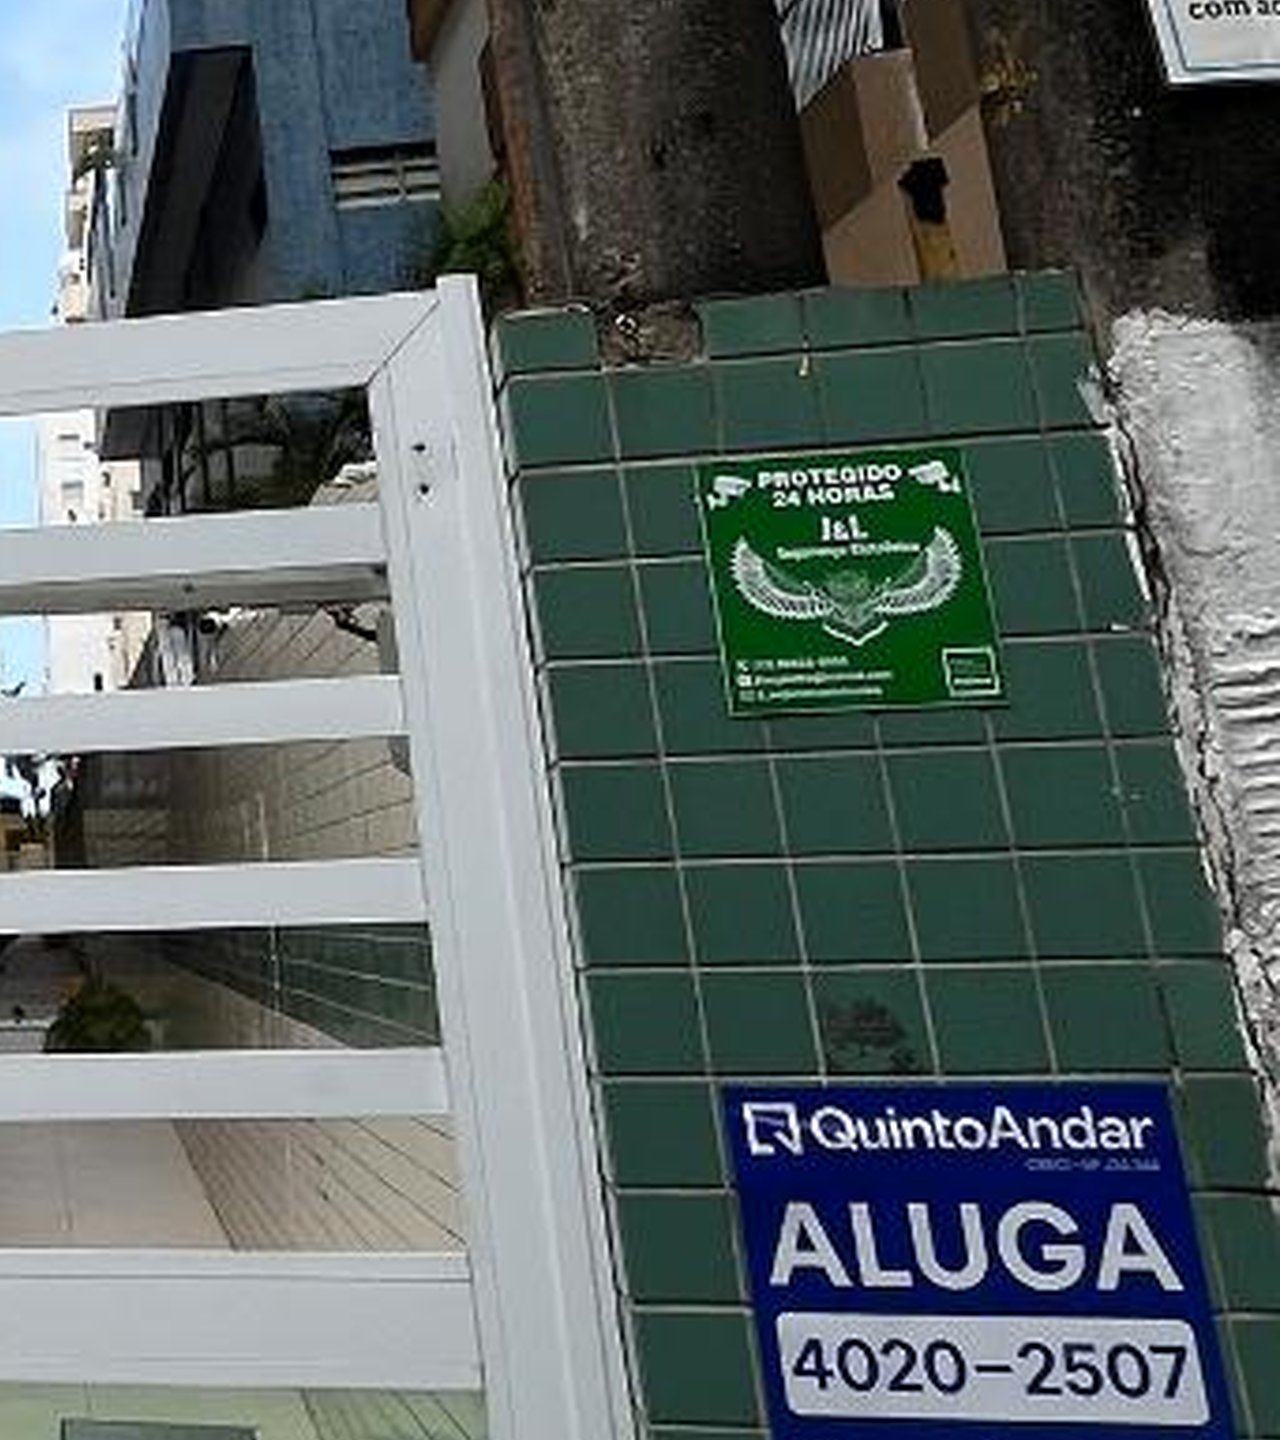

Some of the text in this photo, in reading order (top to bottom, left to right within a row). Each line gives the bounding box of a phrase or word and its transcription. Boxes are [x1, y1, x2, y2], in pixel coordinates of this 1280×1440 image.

[758, 464, 902, 488] PROTEGIDO
[773, 483, 895, 507] 24 HORAS
[809, 1105, 1154, 1155] QuintoAndar
[769, 1200, 1186, 1291] ALUGA
[792, 1338, 1188, 1398] 4020-2507
